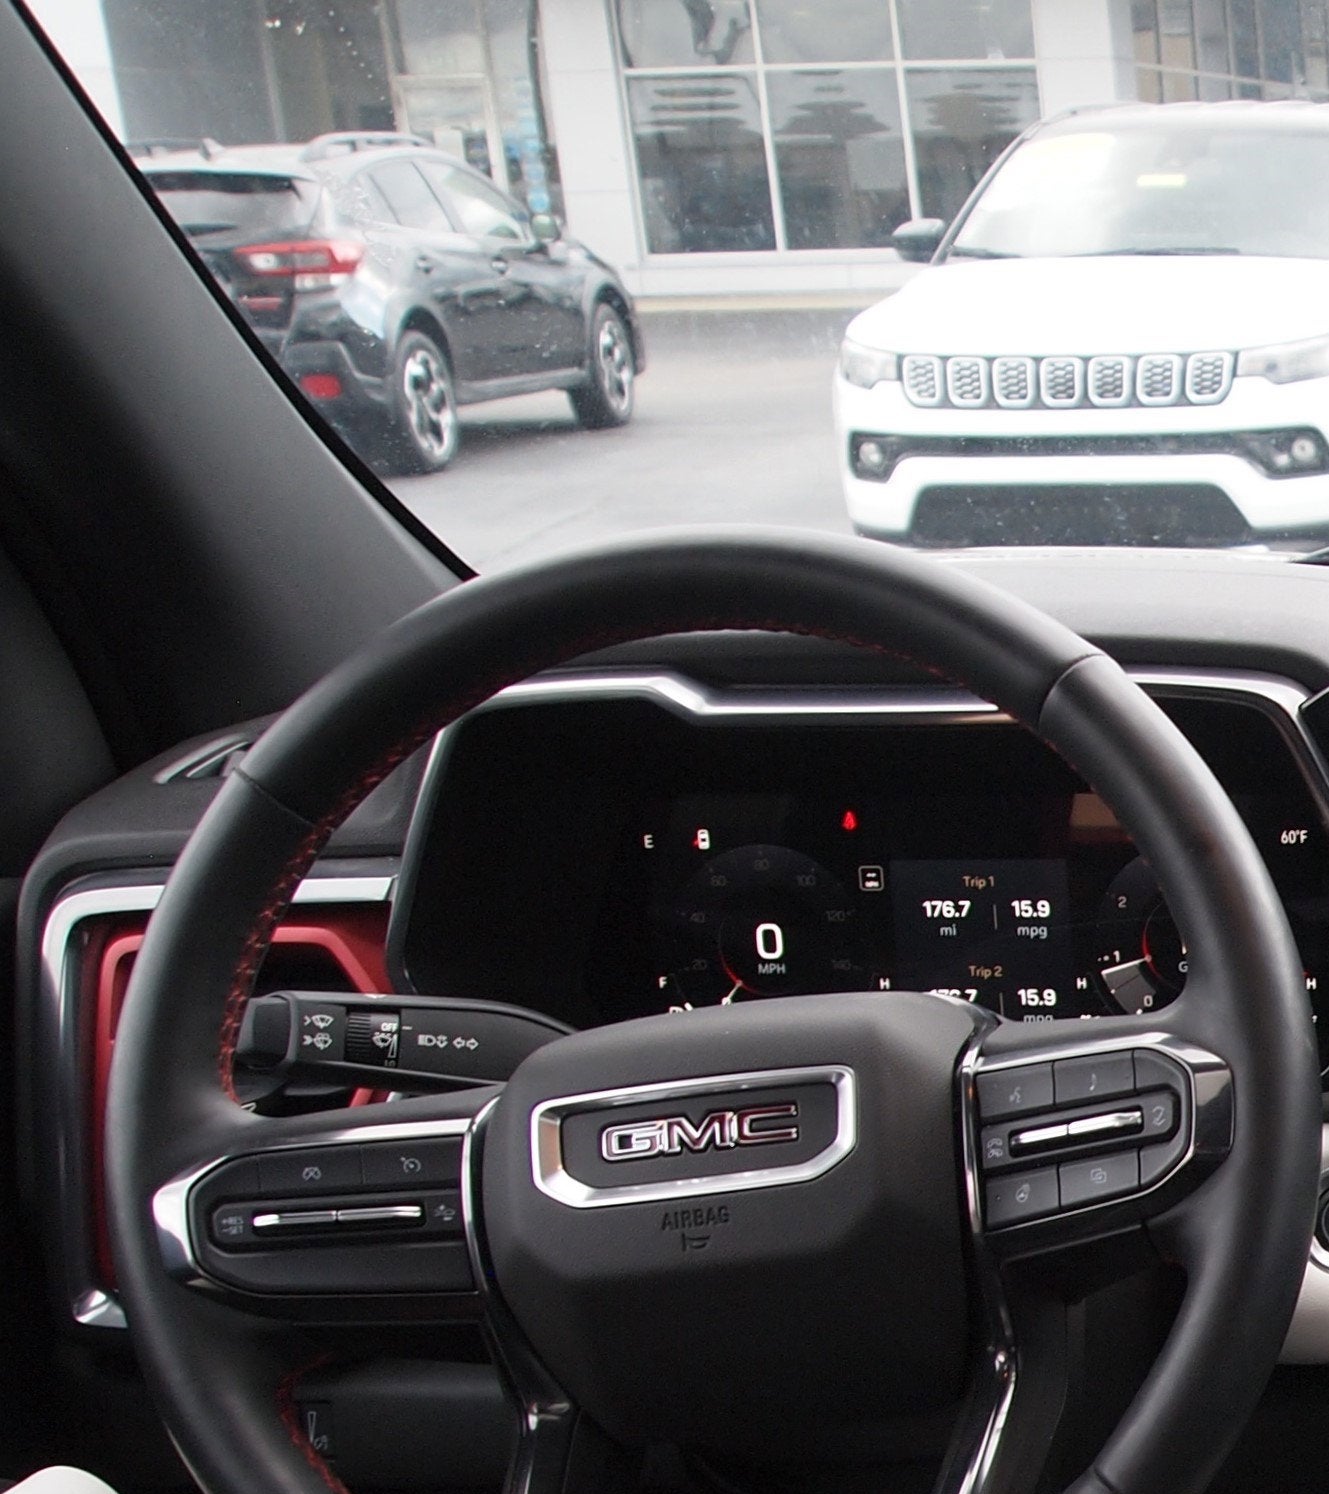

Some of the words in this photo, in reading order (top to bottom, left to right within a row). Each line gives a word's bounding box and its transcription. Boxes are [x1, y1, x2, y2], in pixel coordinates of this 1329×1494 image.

[962, 875, 987, 890] Trip
[989, 875, 996, 888] 1
[921, 899, 972, 919] 176.7
[1010, 899, 1051, 919] 15.9
[1117, 896, 1128, 909] 2
[939, 923, 958, 937] mi
[1016, 926, 1049, 940] mpg
[755, 922, 784, 961] 0
[757, 962, 787, 975] MPH
[968, 965, 993, 980] Trip
[993, 965, 1004, 978] 2
[658, 976, 668, 988] F
[878, 977, 891, 990] H
[1076, 977, 1088, 990] H
[1306, 977, 1318, 991] H
[1016, 988, 1057, 1007] 15.9
[1143, 995, 1154, 1007] 0
[601, 1103, 799, 1163] GMC
[660, 1205, 730, 1231] AIRBAG
